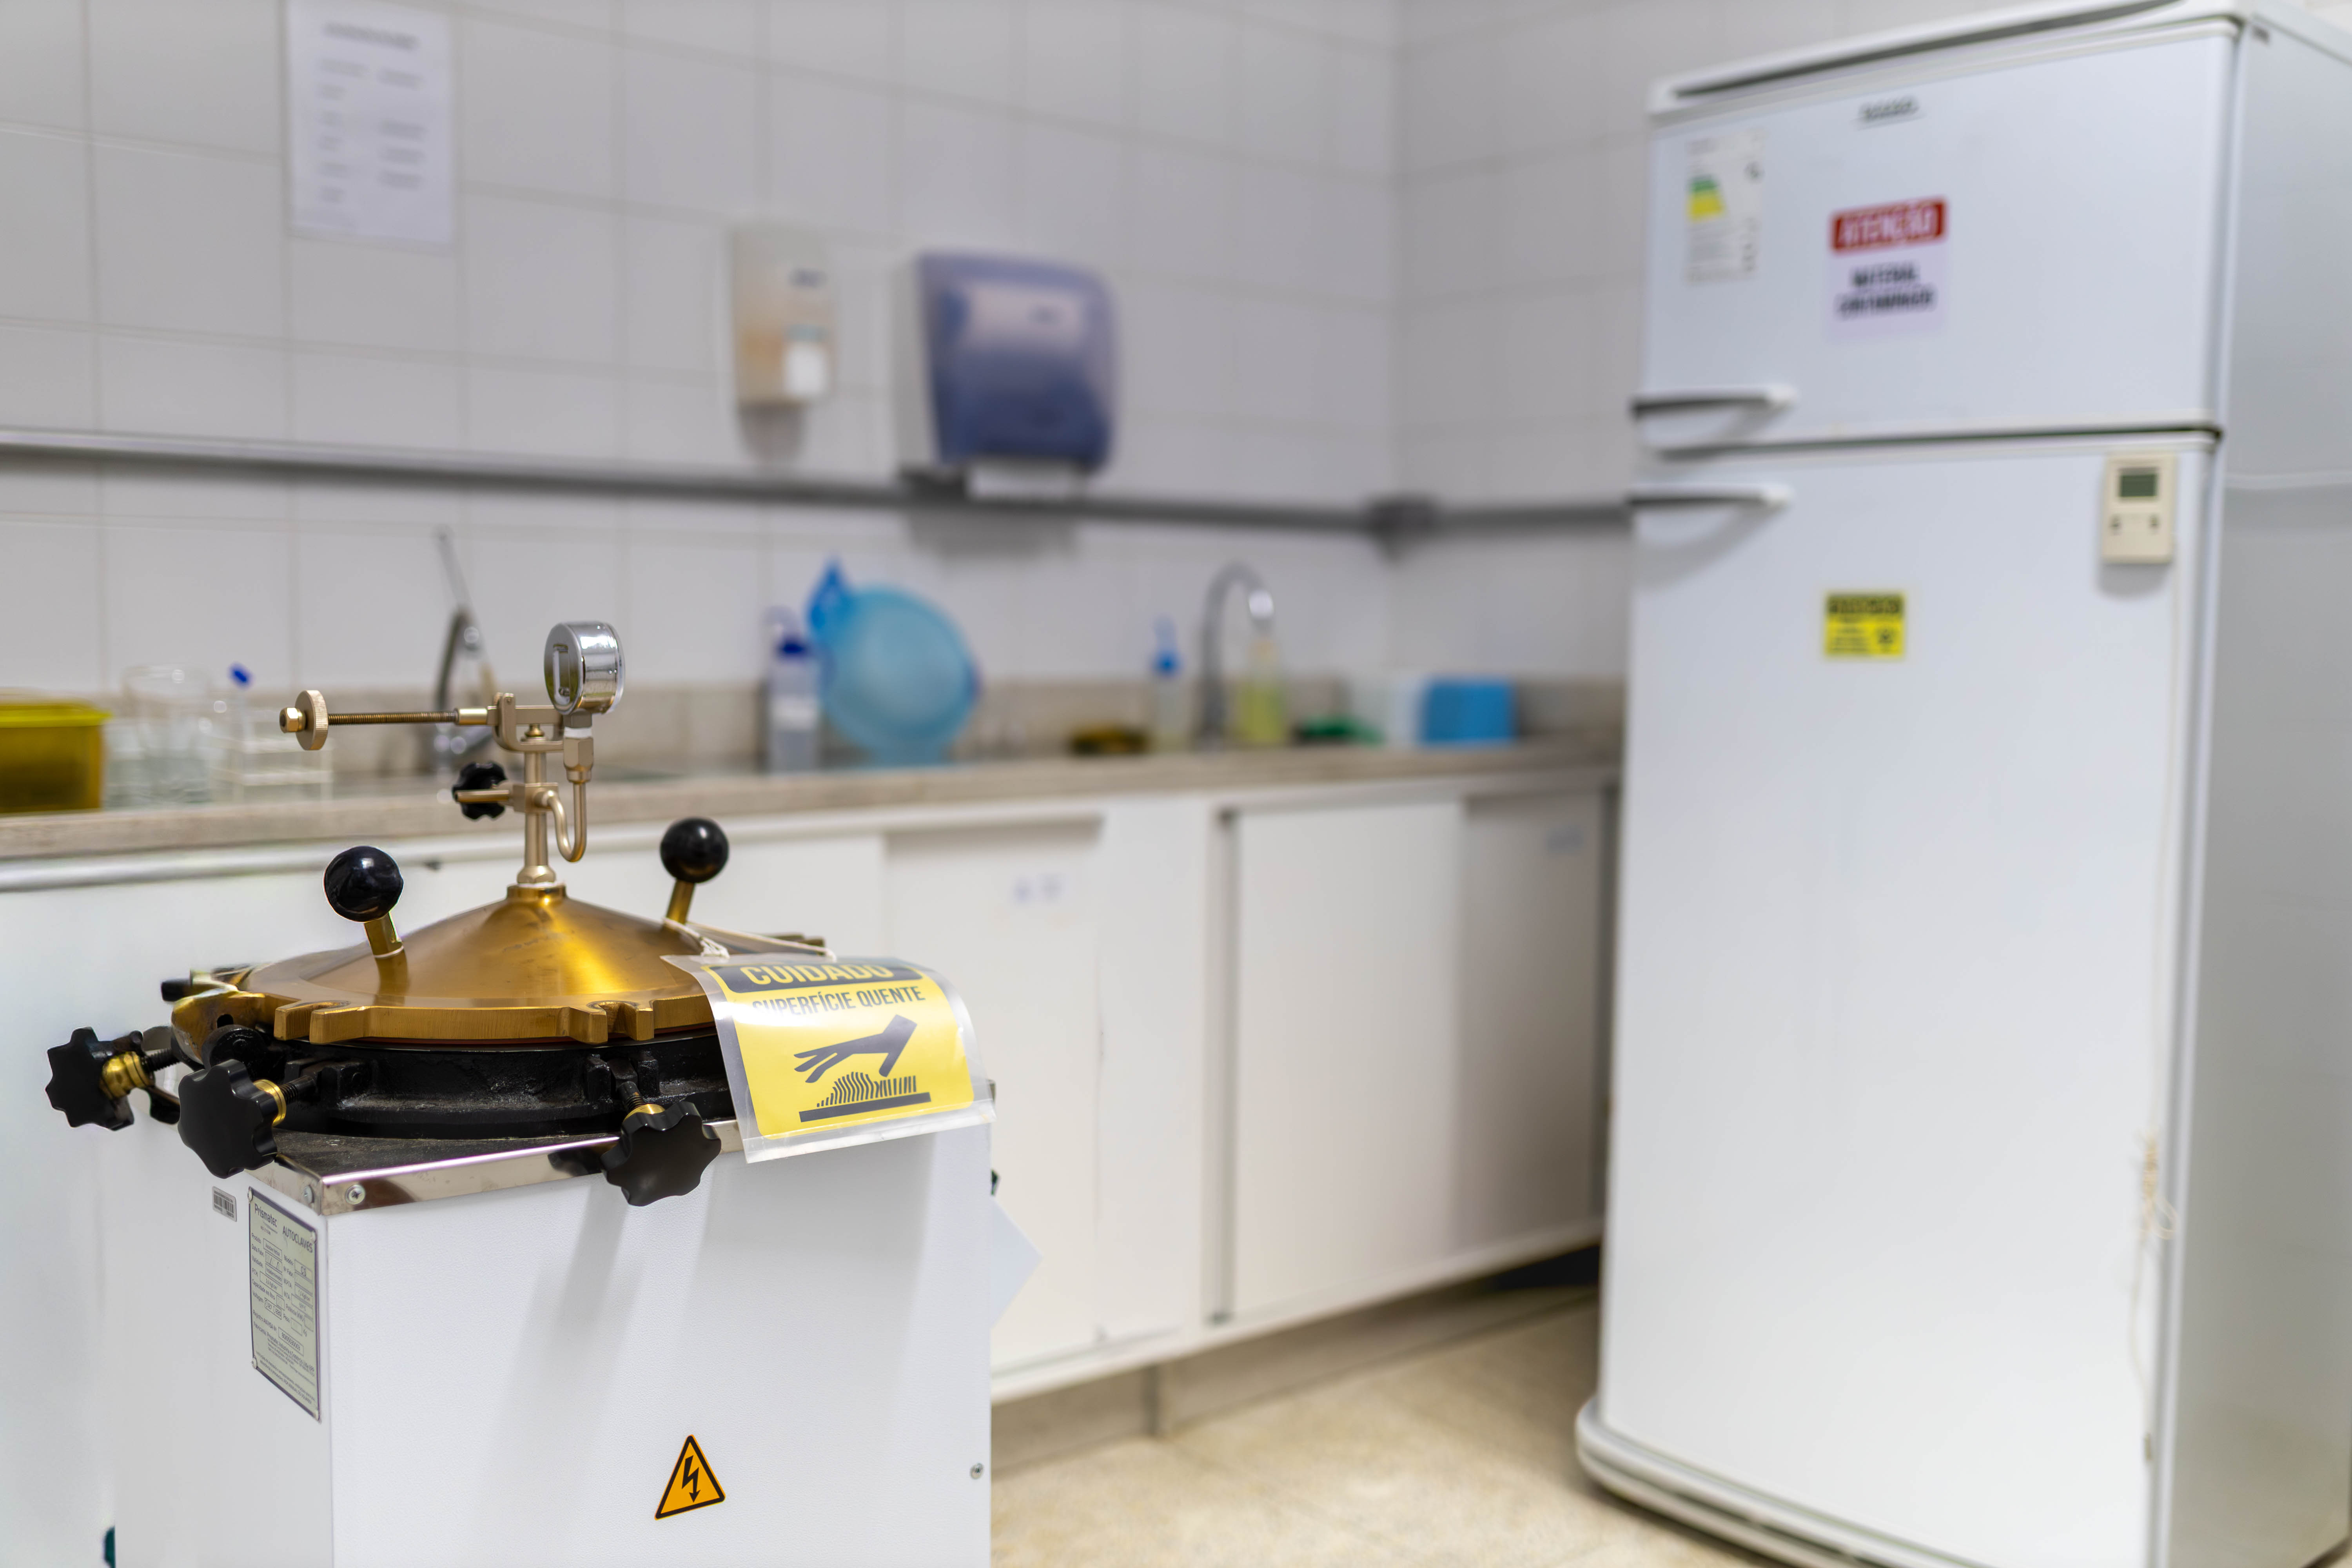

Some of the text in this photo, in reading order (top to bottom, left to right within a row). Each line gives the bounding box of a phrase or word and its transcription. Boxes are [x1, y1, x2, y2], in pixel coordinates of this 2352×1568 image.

[740, 964, 894, 985] CUIDADO
[753, 986, 926, 1016] SUPERFÍCIE QUENTE
[254, 1203, 277, 1227] Prismatec
[282, 1226, 313, 1253] AUTOCLAVES
